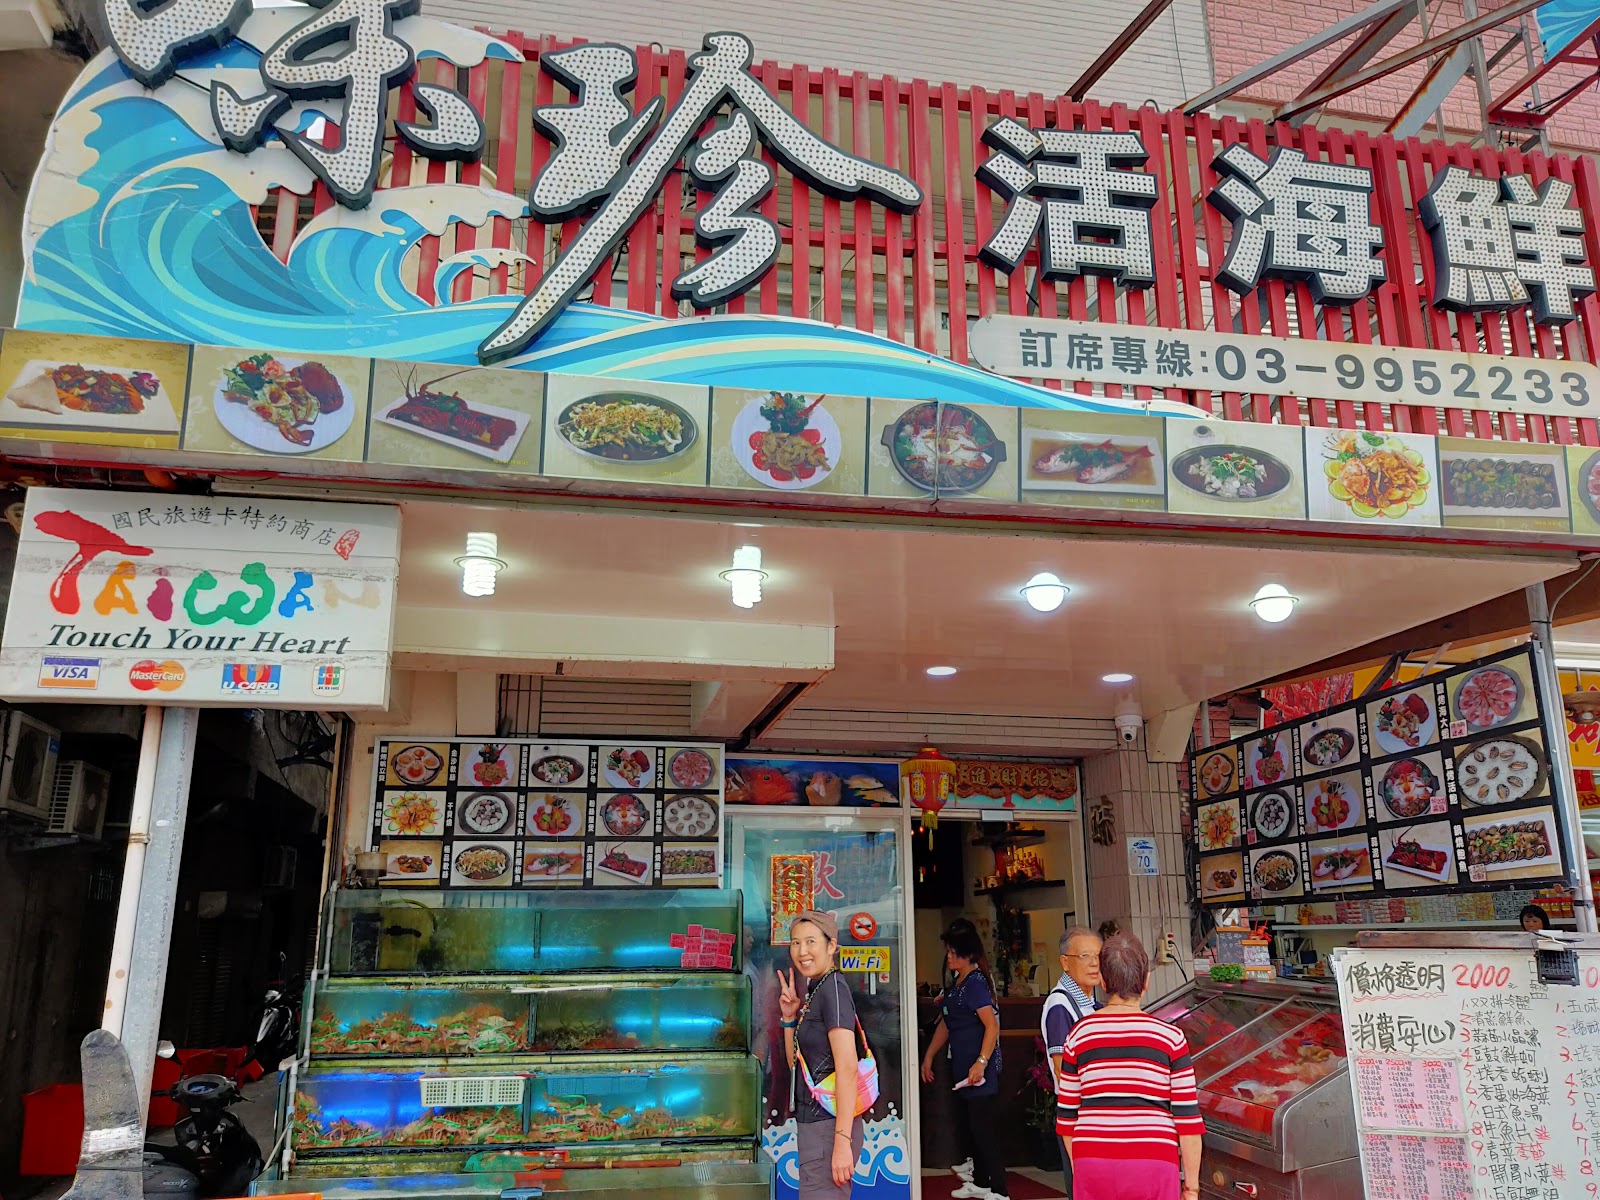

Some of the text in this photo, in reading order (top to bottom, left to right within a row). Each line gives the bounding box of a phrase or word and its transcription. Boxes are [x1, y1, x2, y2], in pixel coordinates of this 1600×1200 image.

[975, 115, 1599, 326] 活海鮮
[112, 505, 337, 548] 國民旅遊卡特約商店
[47, 623, 351, 656] Touch Your Heart
[53, 667, 89, 679] VISA
[130, 670, 184, 681] MasterCard
[237, 681, 279, 691] CARD
[1137, 855, 1150, 868] 70
[842, 956, 881, 969] Wi-Fi
[1346, 961, 1446, 997] 價格透明
[1351, 1012, 1456, 1054] 消費安心
